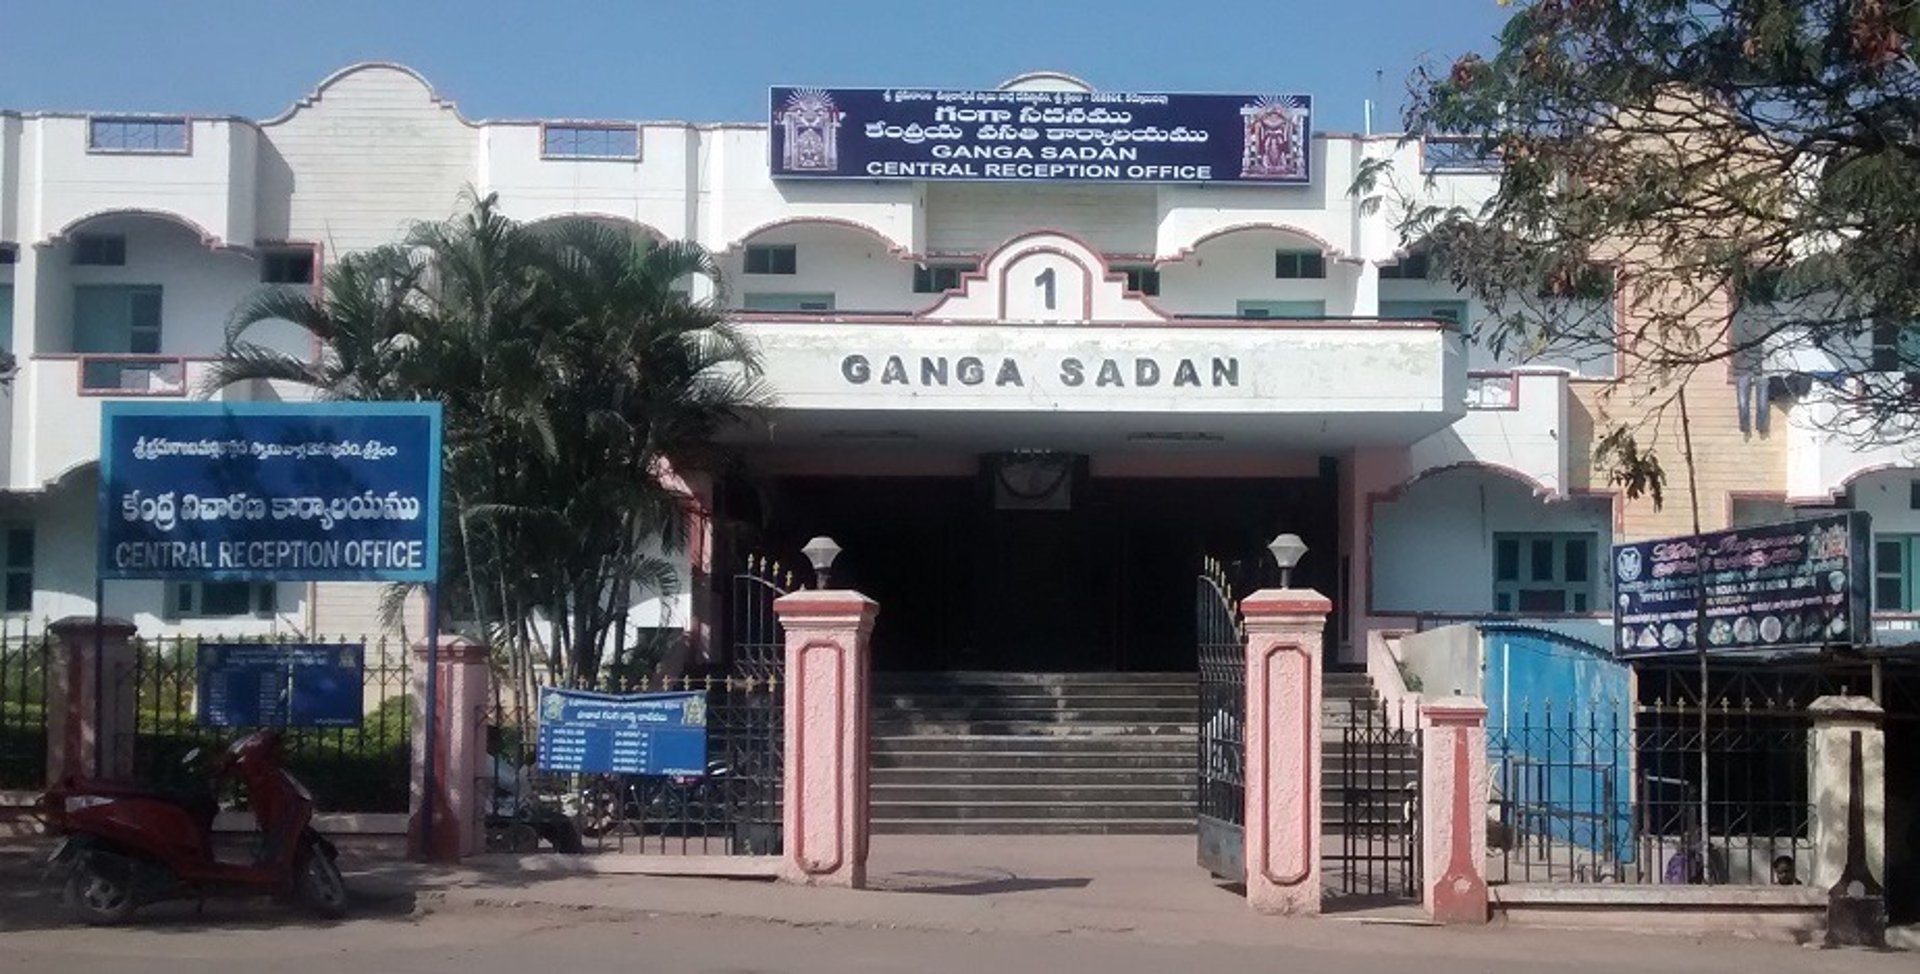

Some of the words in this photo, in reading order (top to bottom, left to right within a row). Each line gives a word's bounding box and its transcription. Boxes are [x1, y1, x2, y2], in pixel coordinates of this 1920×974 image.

[934, 105, 1012, 122] గంగా
[931, 145, 1033, 159] GANGA
[1040, 146, 1138, 161] SADAN
[866, 161, 978, 176] CENTRAL
[984, 163, 1120, 178] RECEPTION
[1127, 165, 1212, 180] OFFICE
[1033, 267, 1058, 311] 1
[841, 354, 1024, 387] GANGA
[1059, 357, 1240, 388] SADAN
[121, 490, 176, 531] కేంద్ర
[115, 540, 213, 568] CENTRAL
[218, 540, 339, 568] RECEPTION
[345, 541, 423, 568] OFFICE
